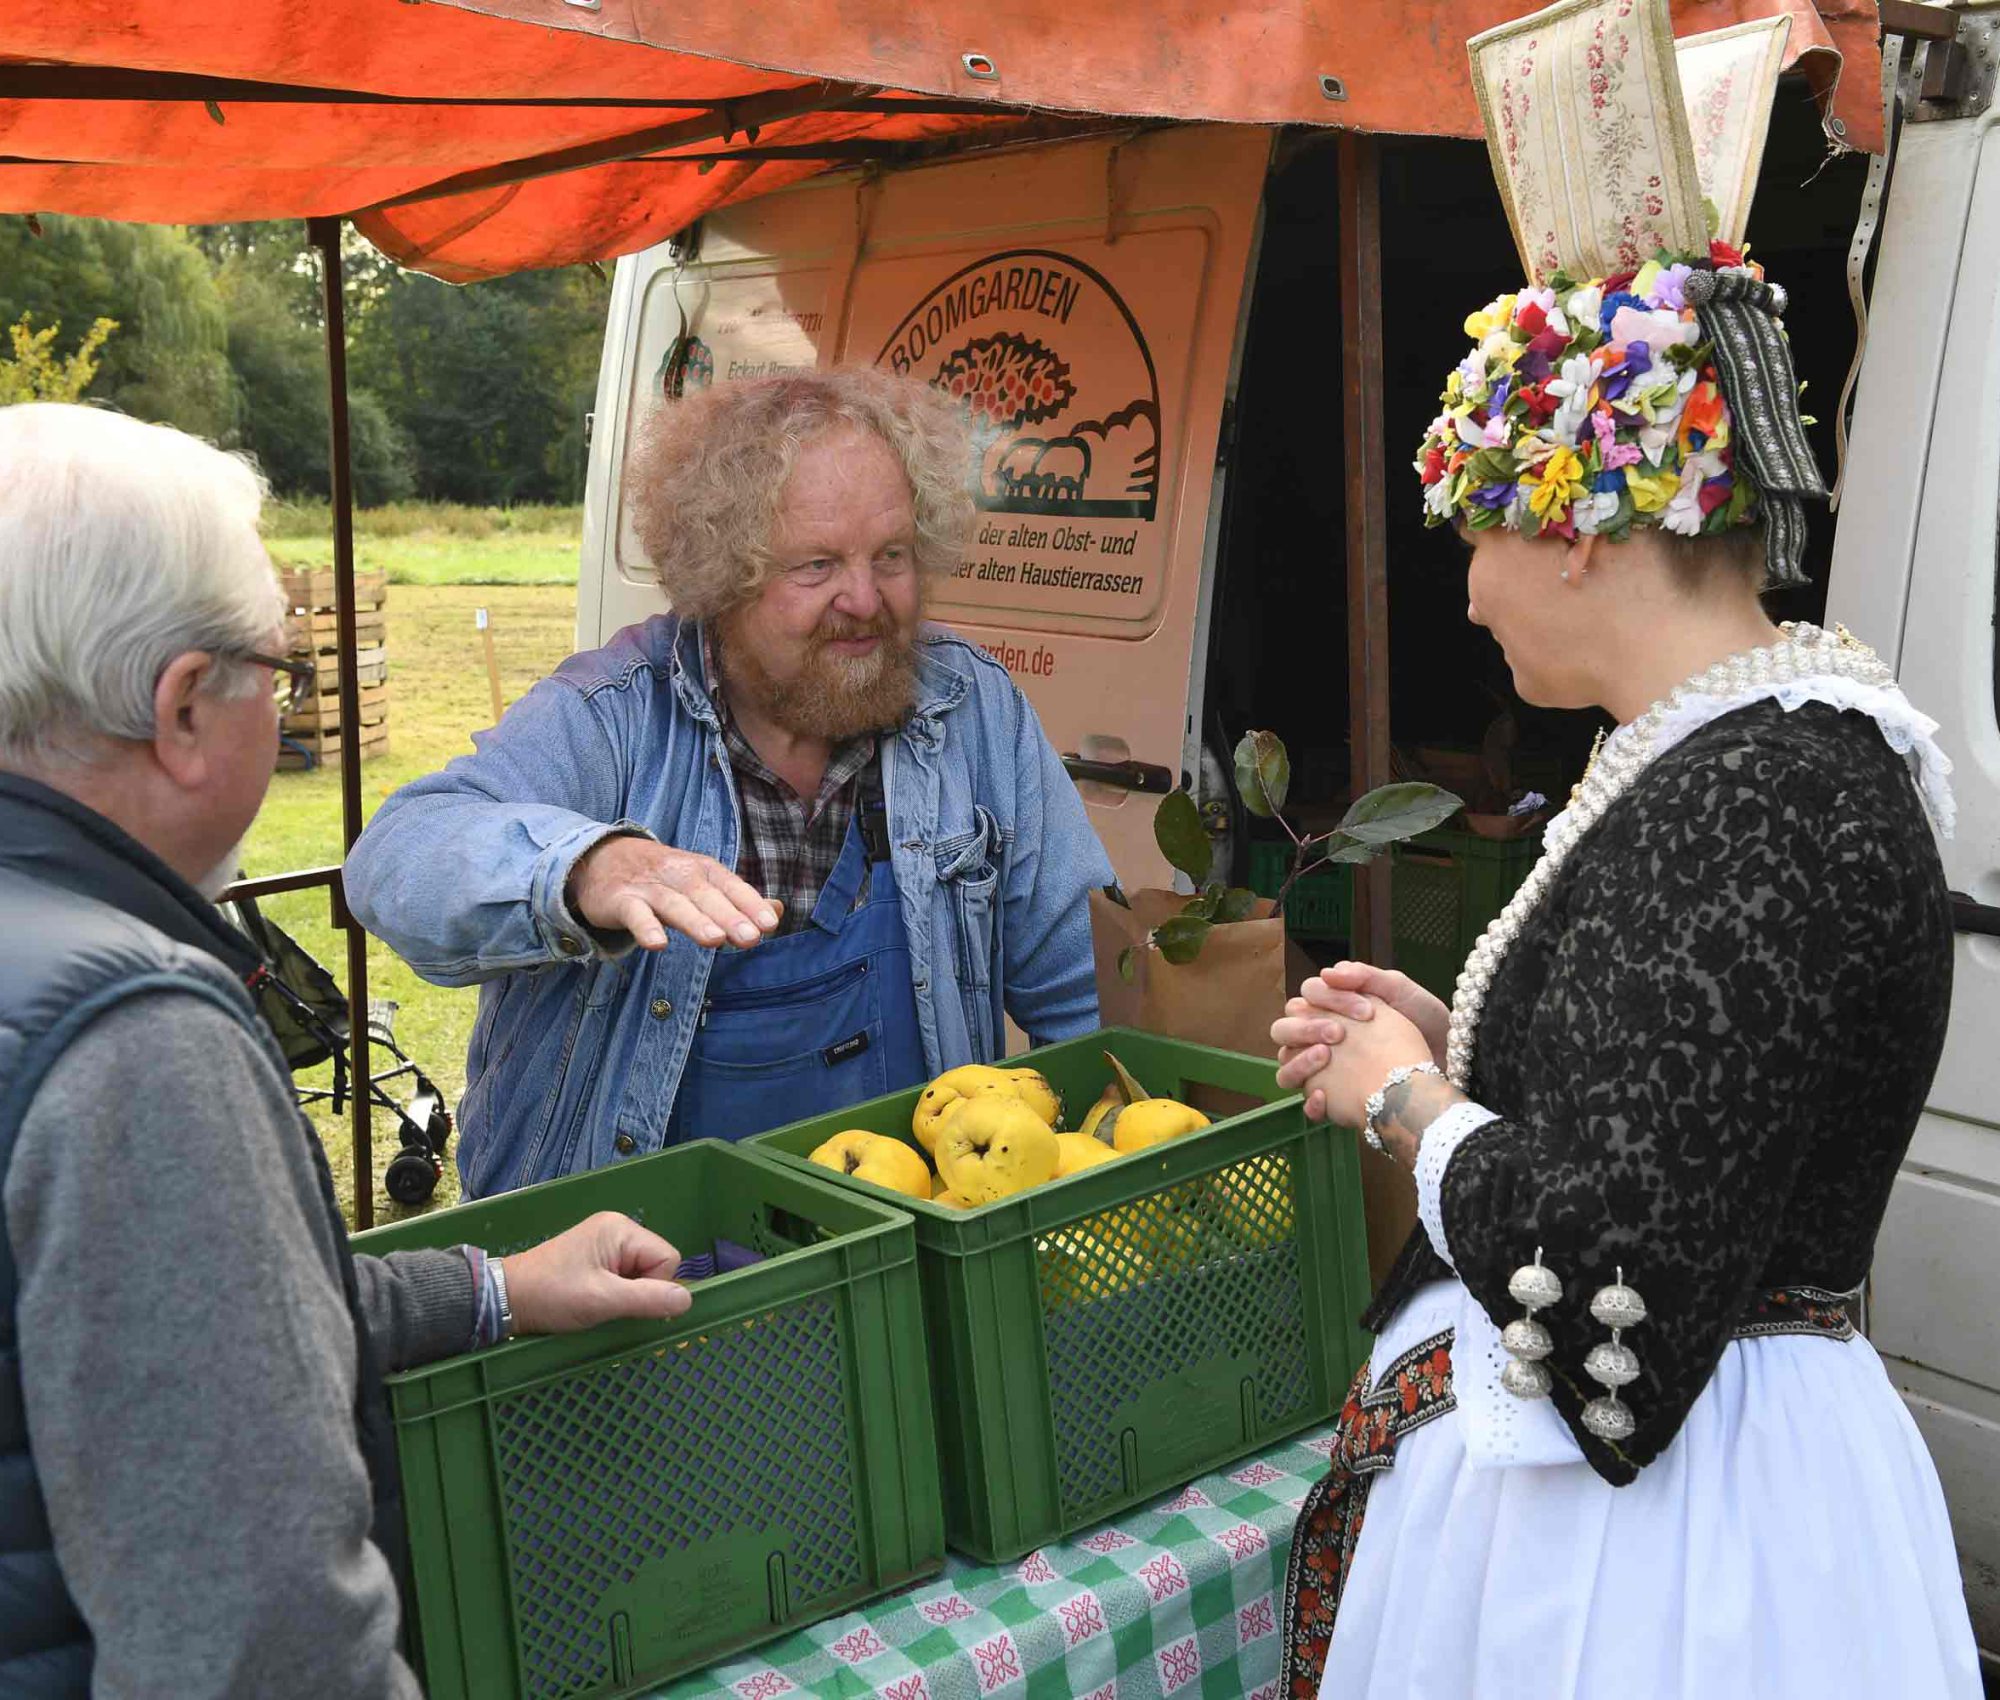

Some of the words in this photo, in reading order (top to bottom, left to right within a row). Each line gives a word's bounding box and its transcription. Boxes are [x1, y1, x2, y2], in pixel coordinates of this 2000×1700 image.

[890, 267, 1081, 375] BOOMGARDEN
[978, 521, 1006, 545] der
[1008, 523, 1048, 549] alten
[1052, 526, 1096, 552] Obst-
[1100, 530, 1138, 555] und
[977, 557, 1016, 582] alten
[1019, 561, 1144, 594] Haustierrassen
